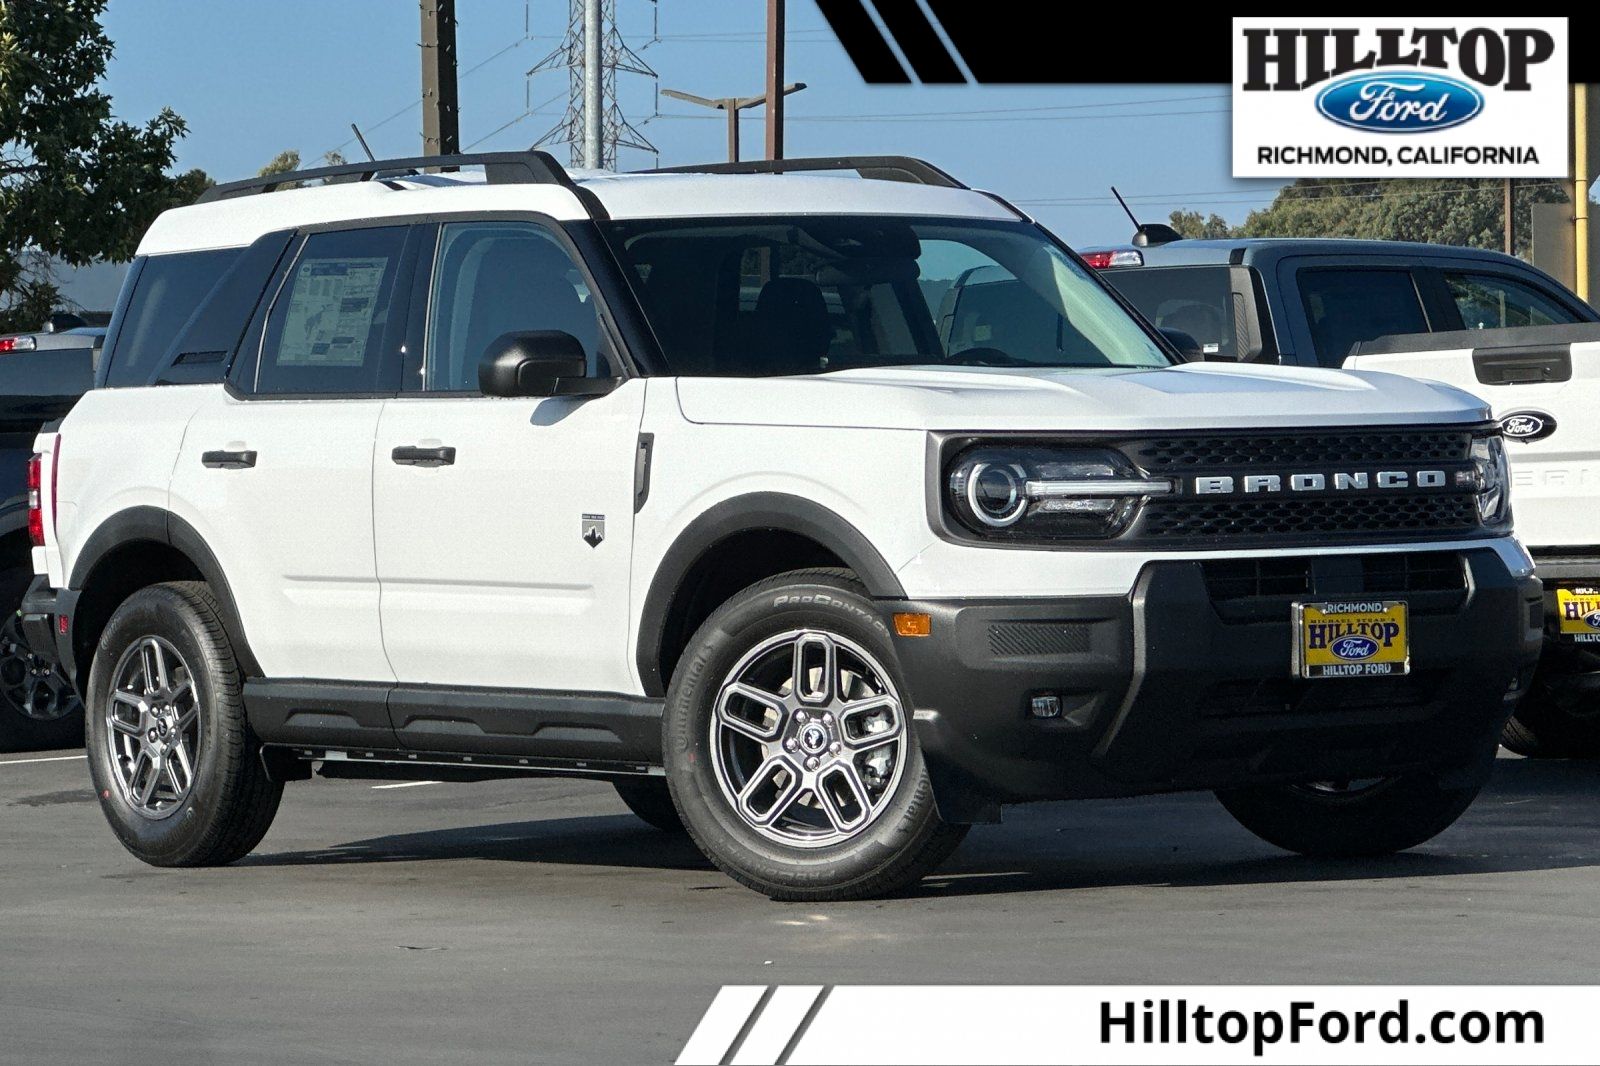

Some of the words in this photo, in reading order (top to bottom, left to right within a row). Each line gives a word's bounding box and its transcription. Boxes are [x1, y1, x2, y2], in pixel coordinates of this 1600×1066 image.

[1507, 418, 1534, 433] Ford
[1195, 470, 1446, 495] BRONCO
[1326, 602, 1383, 614] RICHMOND
[1308, 622, 1400, 649] HILLTOP
[1340, 639, 1370, 656] Ford
[1322, 664, 1363, 676] HILLTOP
[1365, 663, 1392, 674] FORD
